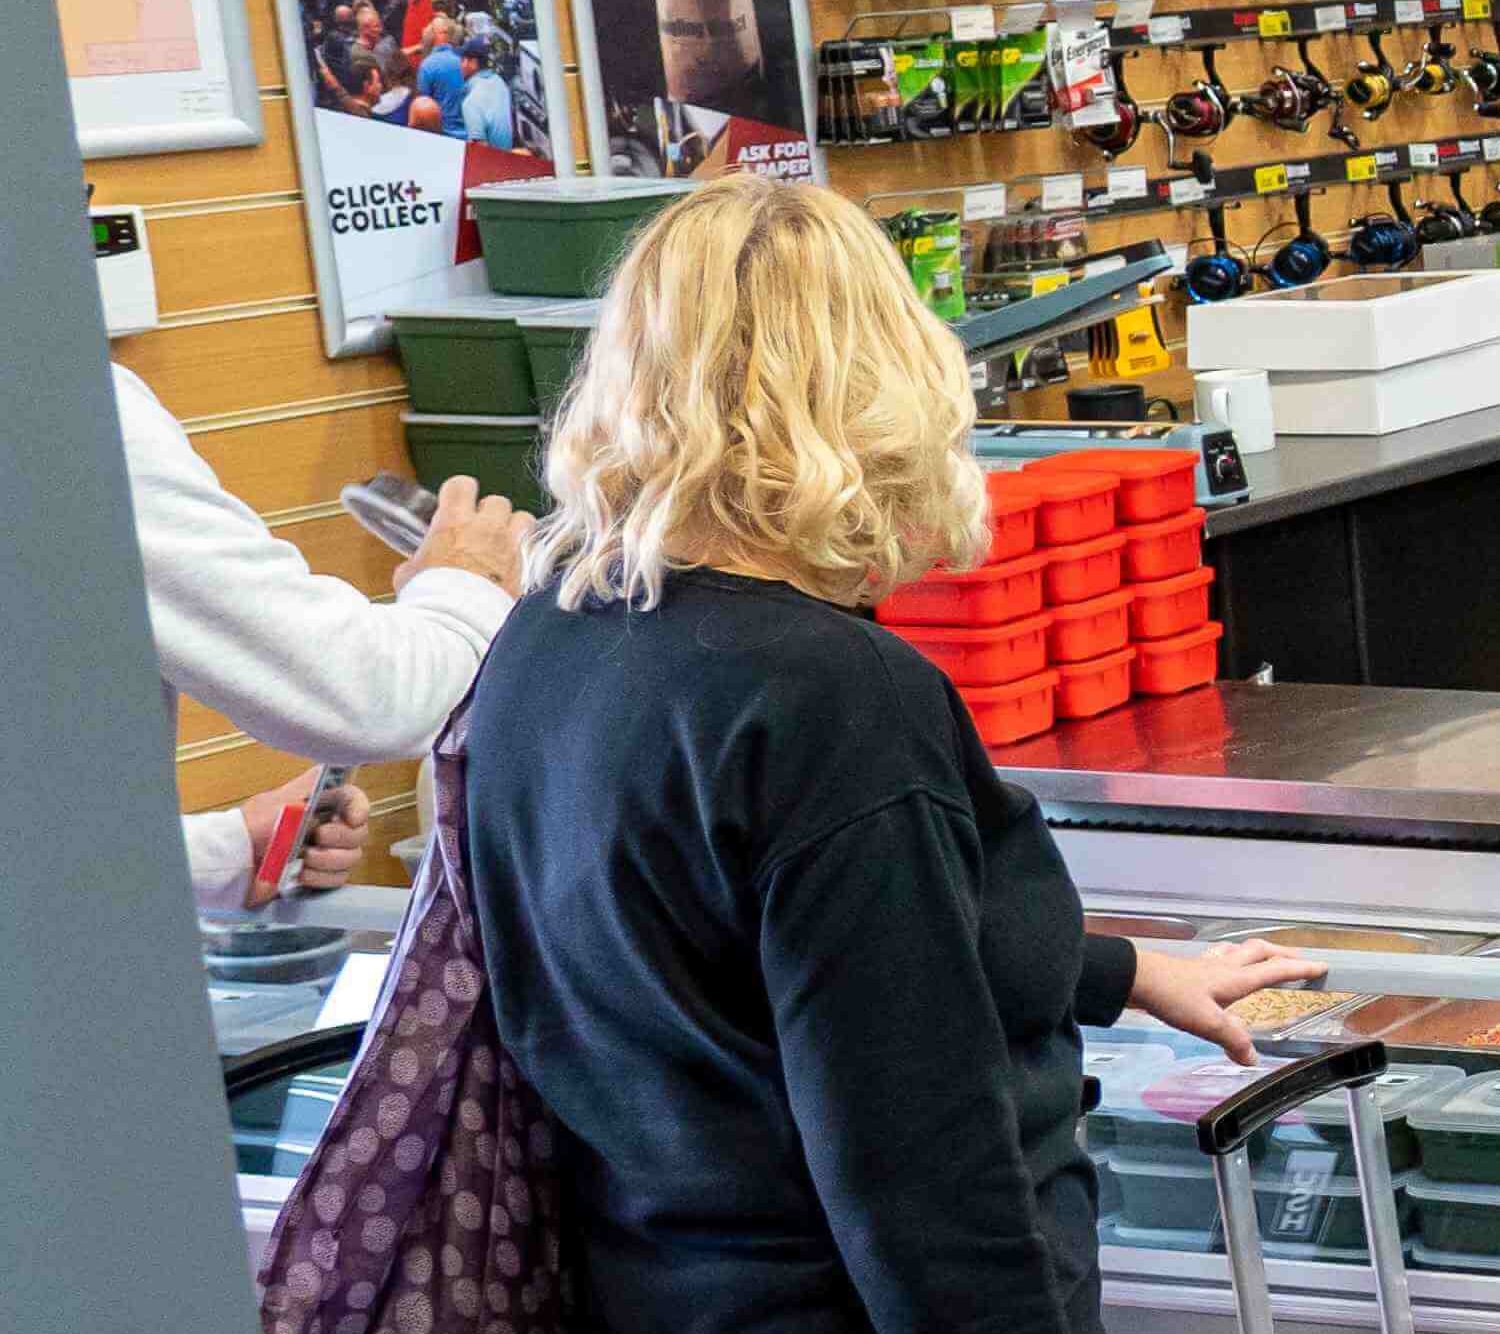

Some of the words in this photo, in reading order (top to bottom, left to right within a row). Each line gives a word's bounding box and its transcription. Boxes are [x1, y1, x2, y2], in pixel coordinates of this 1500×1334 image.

[738, 145, 771, 162] ASK
[775, 141, 809, 158] FOR
[331, 202, 444, 234] COLLECT
